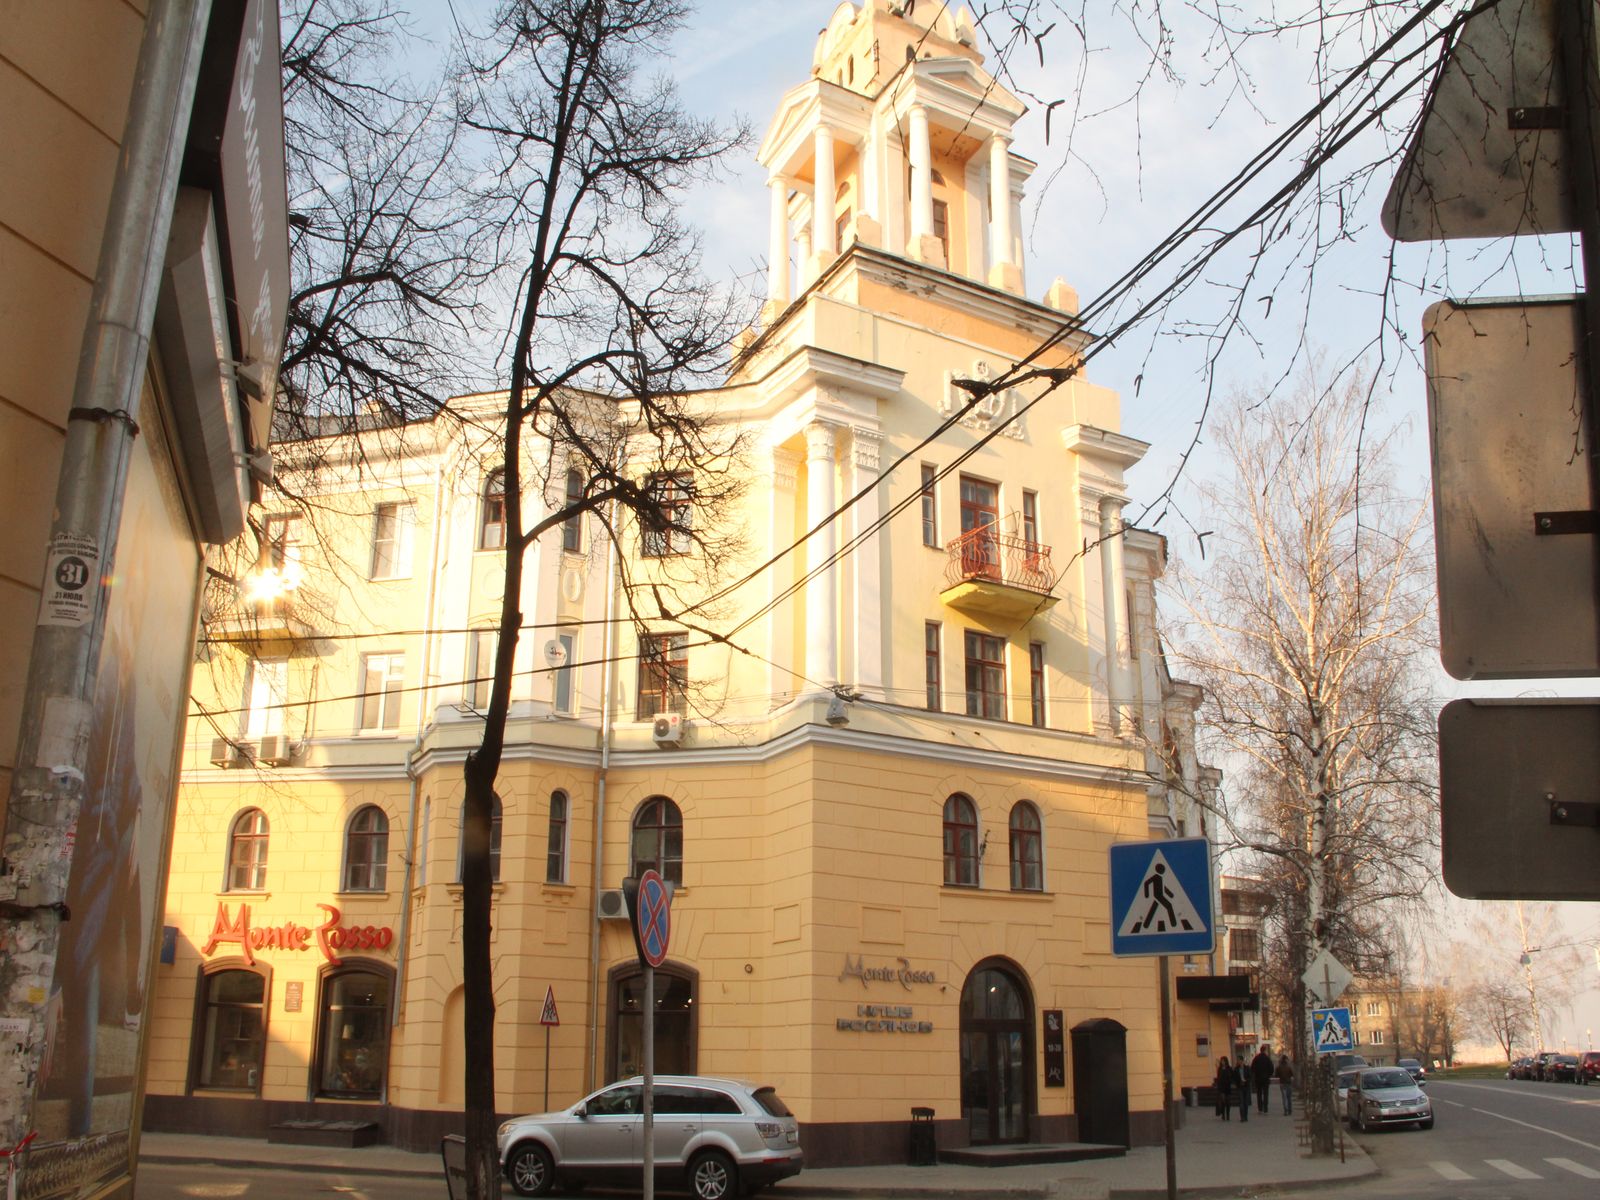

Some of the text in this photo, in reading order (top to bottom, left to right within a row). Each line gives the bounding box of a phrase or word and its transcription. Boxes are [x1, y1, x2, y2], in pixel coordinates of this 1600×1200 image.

[60, 563, 84, 585] 31
[201, 902, 394, 966] Monte Rosso
[839, 953, 936, 991] Monte Rosso
